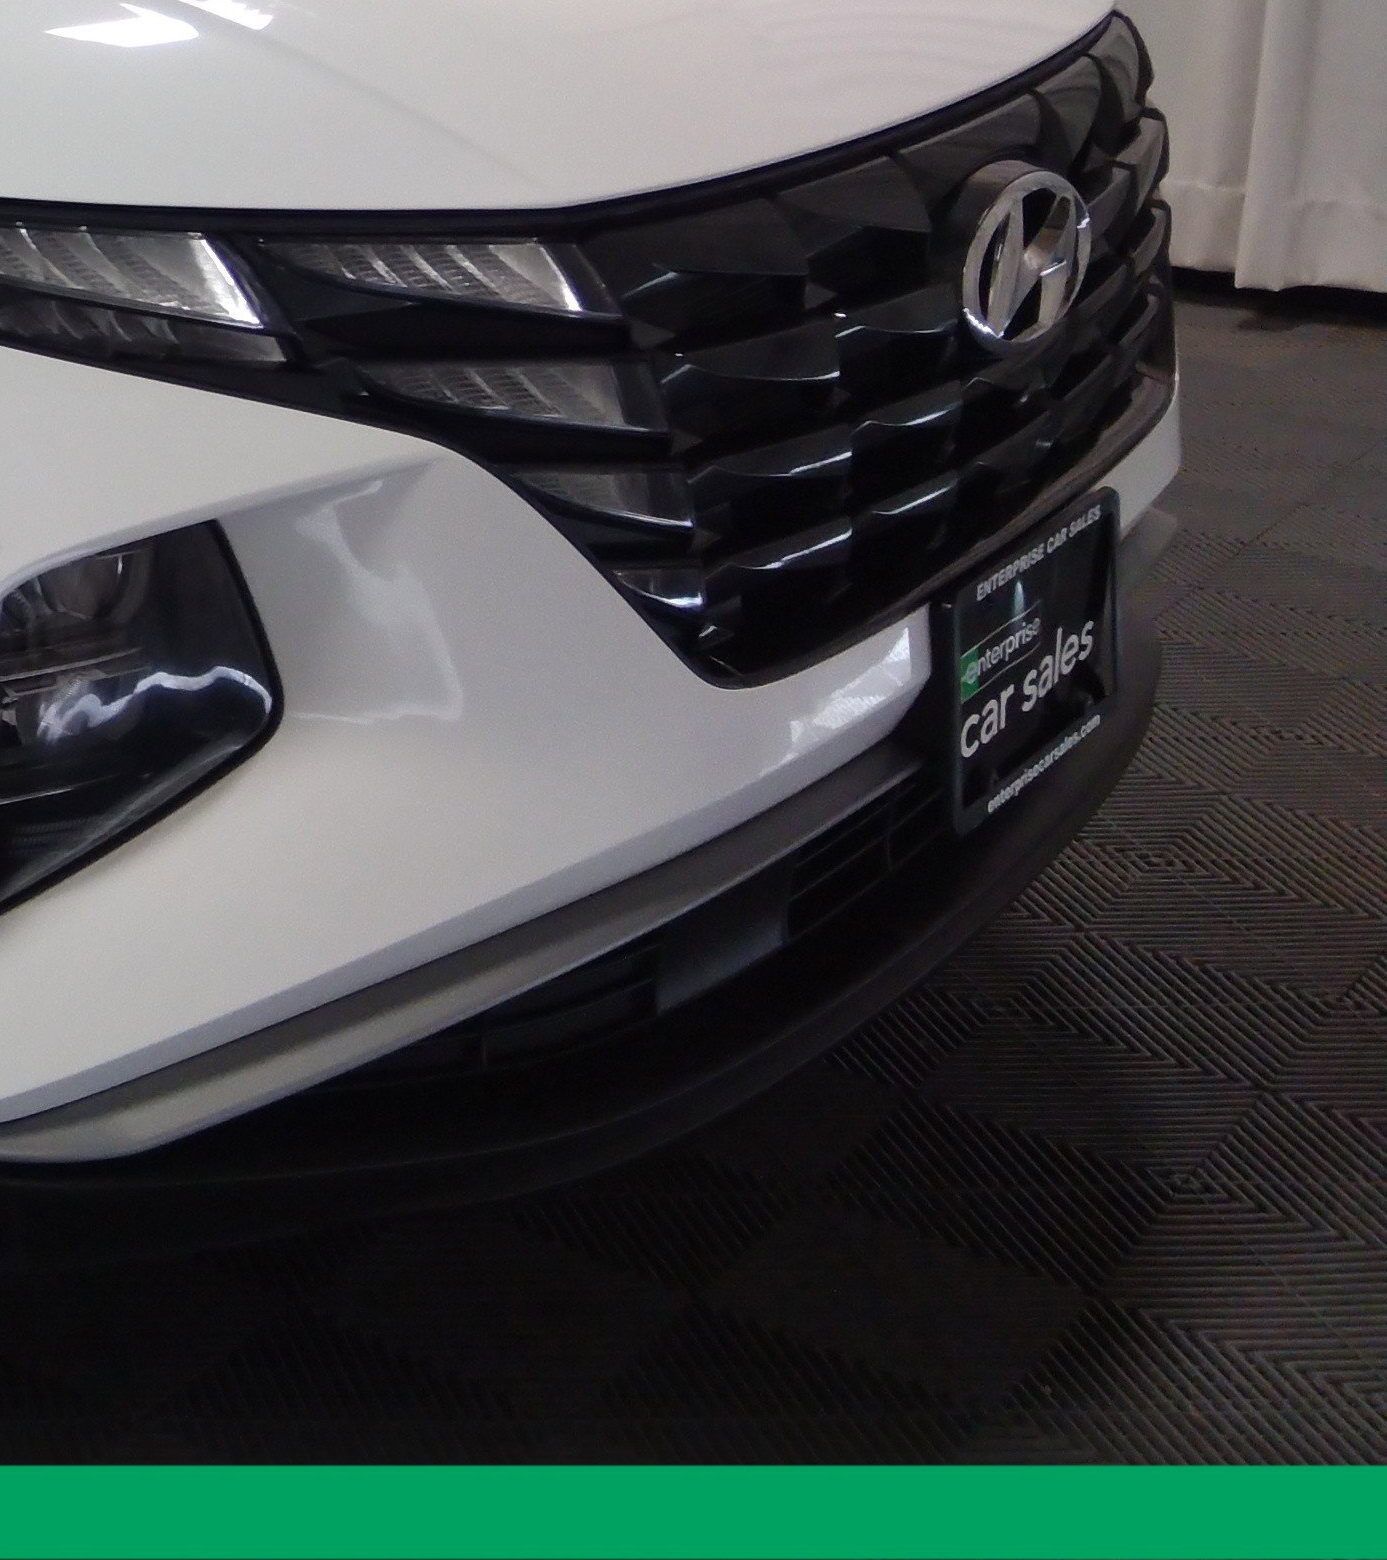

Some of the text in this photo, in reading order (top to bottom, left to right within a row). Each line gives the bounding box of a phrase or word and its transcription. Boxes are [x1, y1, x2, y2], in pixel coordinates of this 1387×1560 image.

[976, 504, 1102, 602] ENTERPRISE CAR SALES
[960, 619, 1095, 759] car sales
[963, 616, 1042, 686] enterprise
[987, 713, 1101, 814] enterprisecarsales.com
